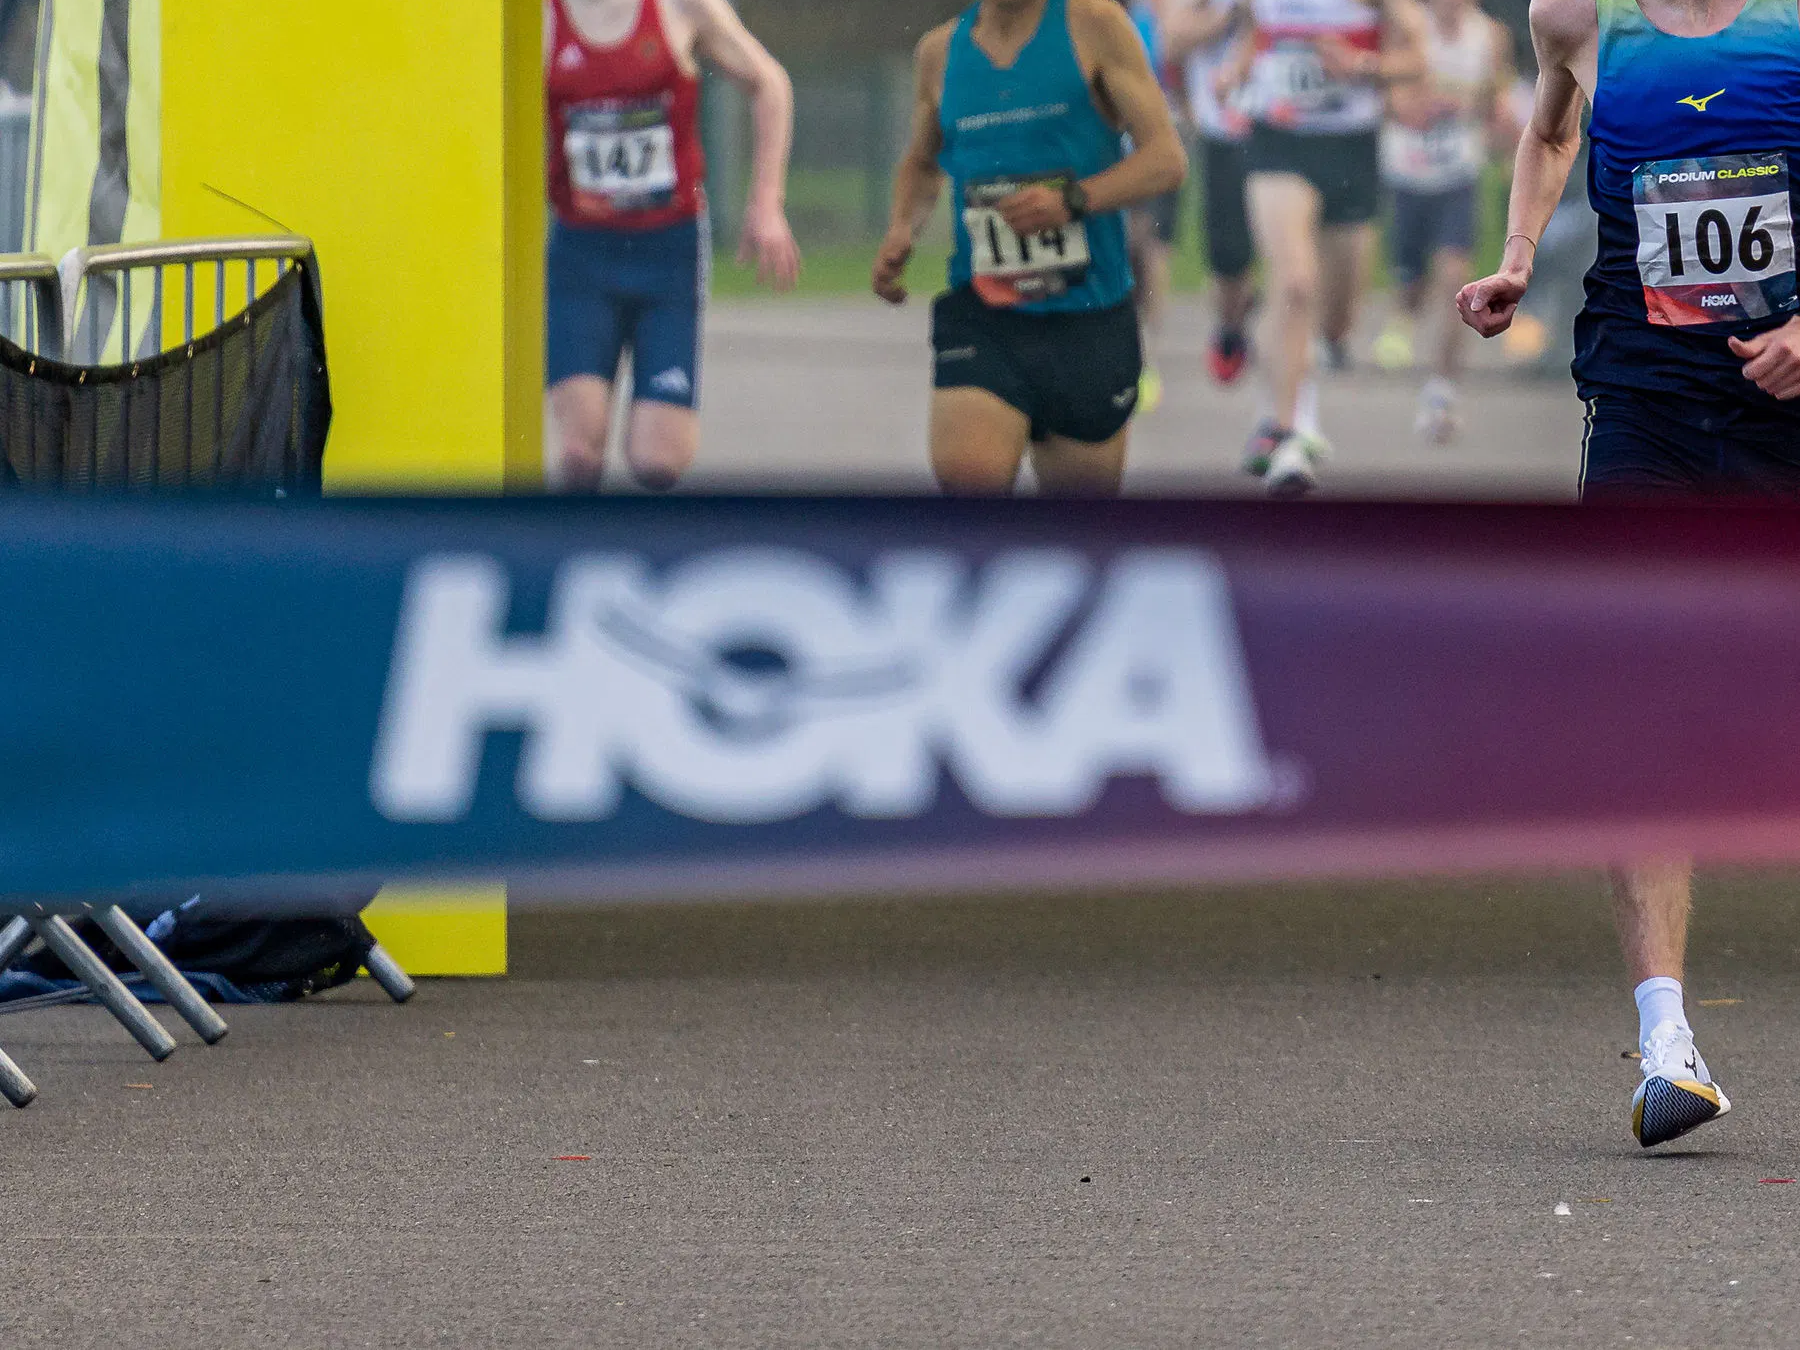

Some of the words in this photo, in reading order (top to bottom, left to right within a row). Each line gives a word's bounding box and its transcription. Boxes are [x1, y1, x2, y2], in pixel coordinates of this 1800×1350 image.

[1658, 170, 1716, 184] PODIUM
[1716, 165, 1779, 180] CLASSIC
[1664, 205, 1775, 277] 106
[1701, 294, 1738, 307] HOKA
[370, 548, 1270, 823] HOKA
